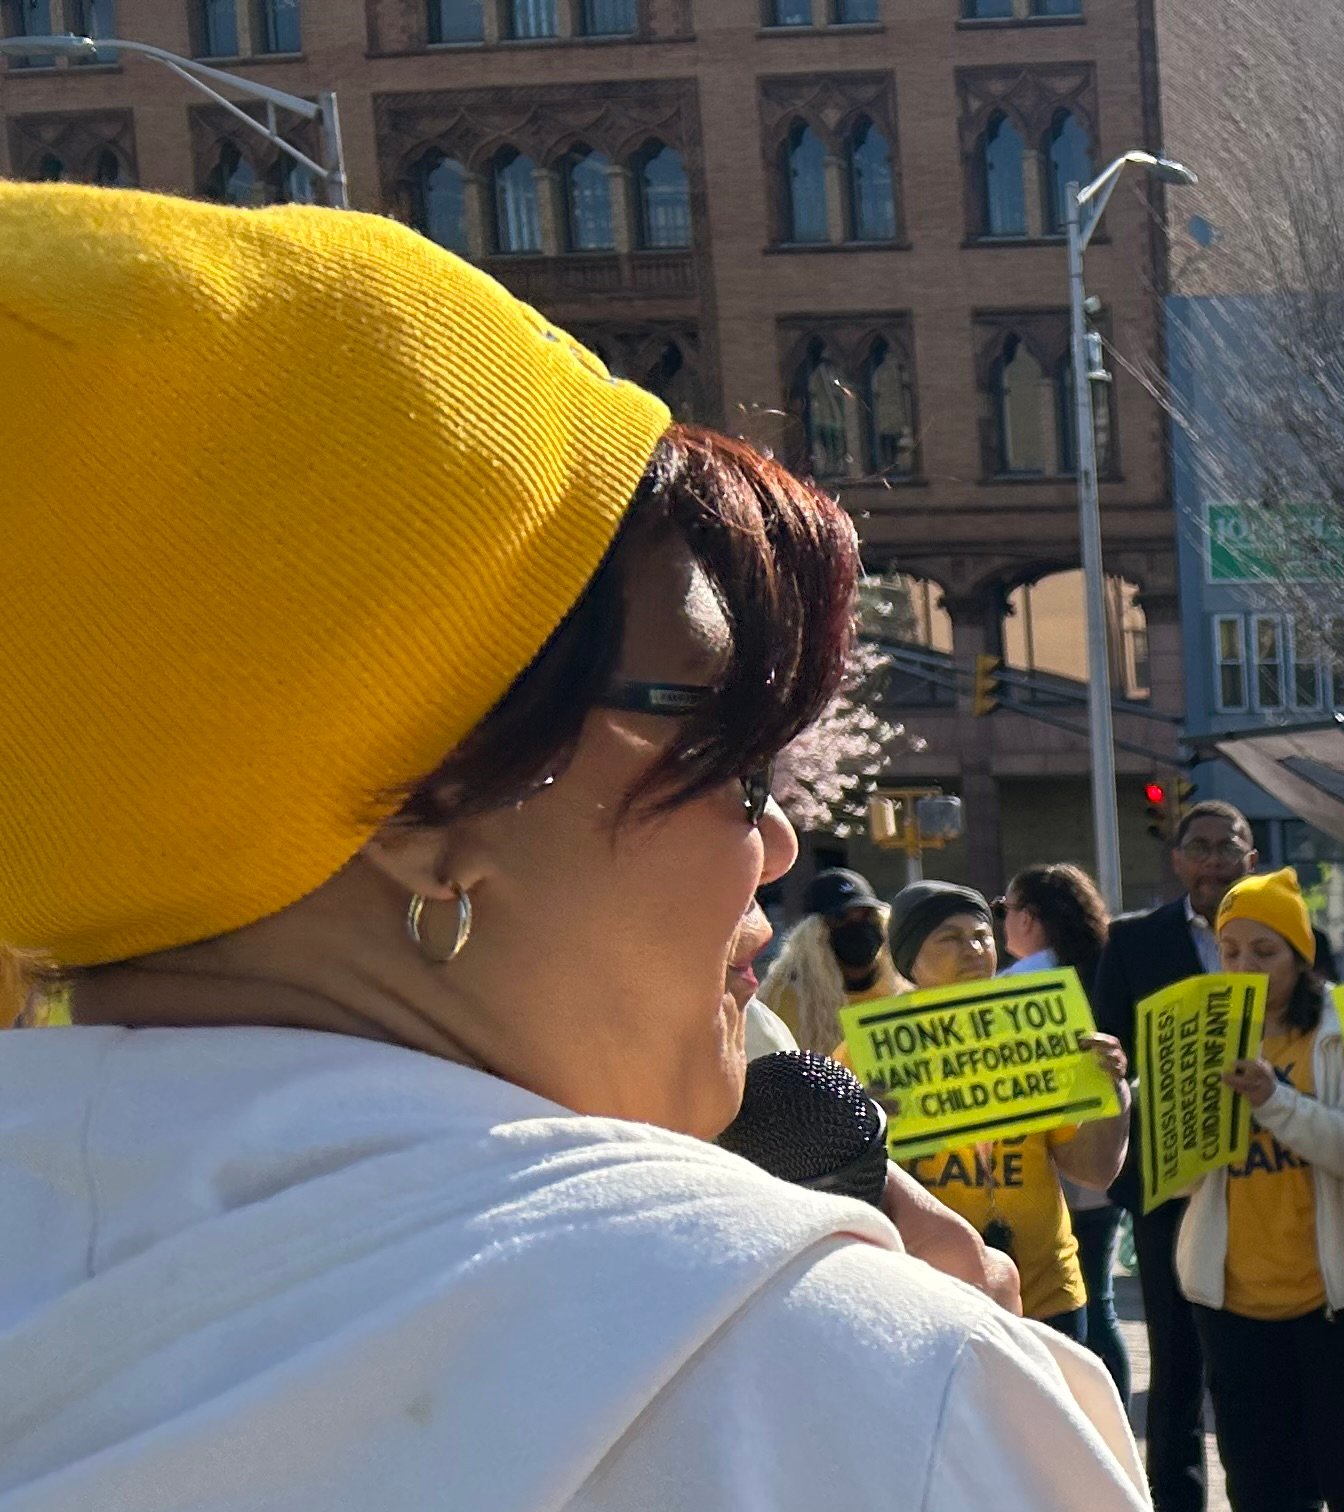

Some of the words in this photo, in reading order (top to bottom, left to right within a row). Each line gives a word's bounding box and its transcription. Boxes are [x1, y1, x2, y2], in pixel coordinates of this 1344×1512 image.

[869, 1015, 966, 1061] HONK
[969, 1006, 994, 1041] IF
[1003, 994, 1068, 1034] YOU
[941, 1028, 1091, 1081] AFFORDABLE
[920, 1083, 989, 1118] CHILD
[993, 1068, 1059, 1101] CARE
